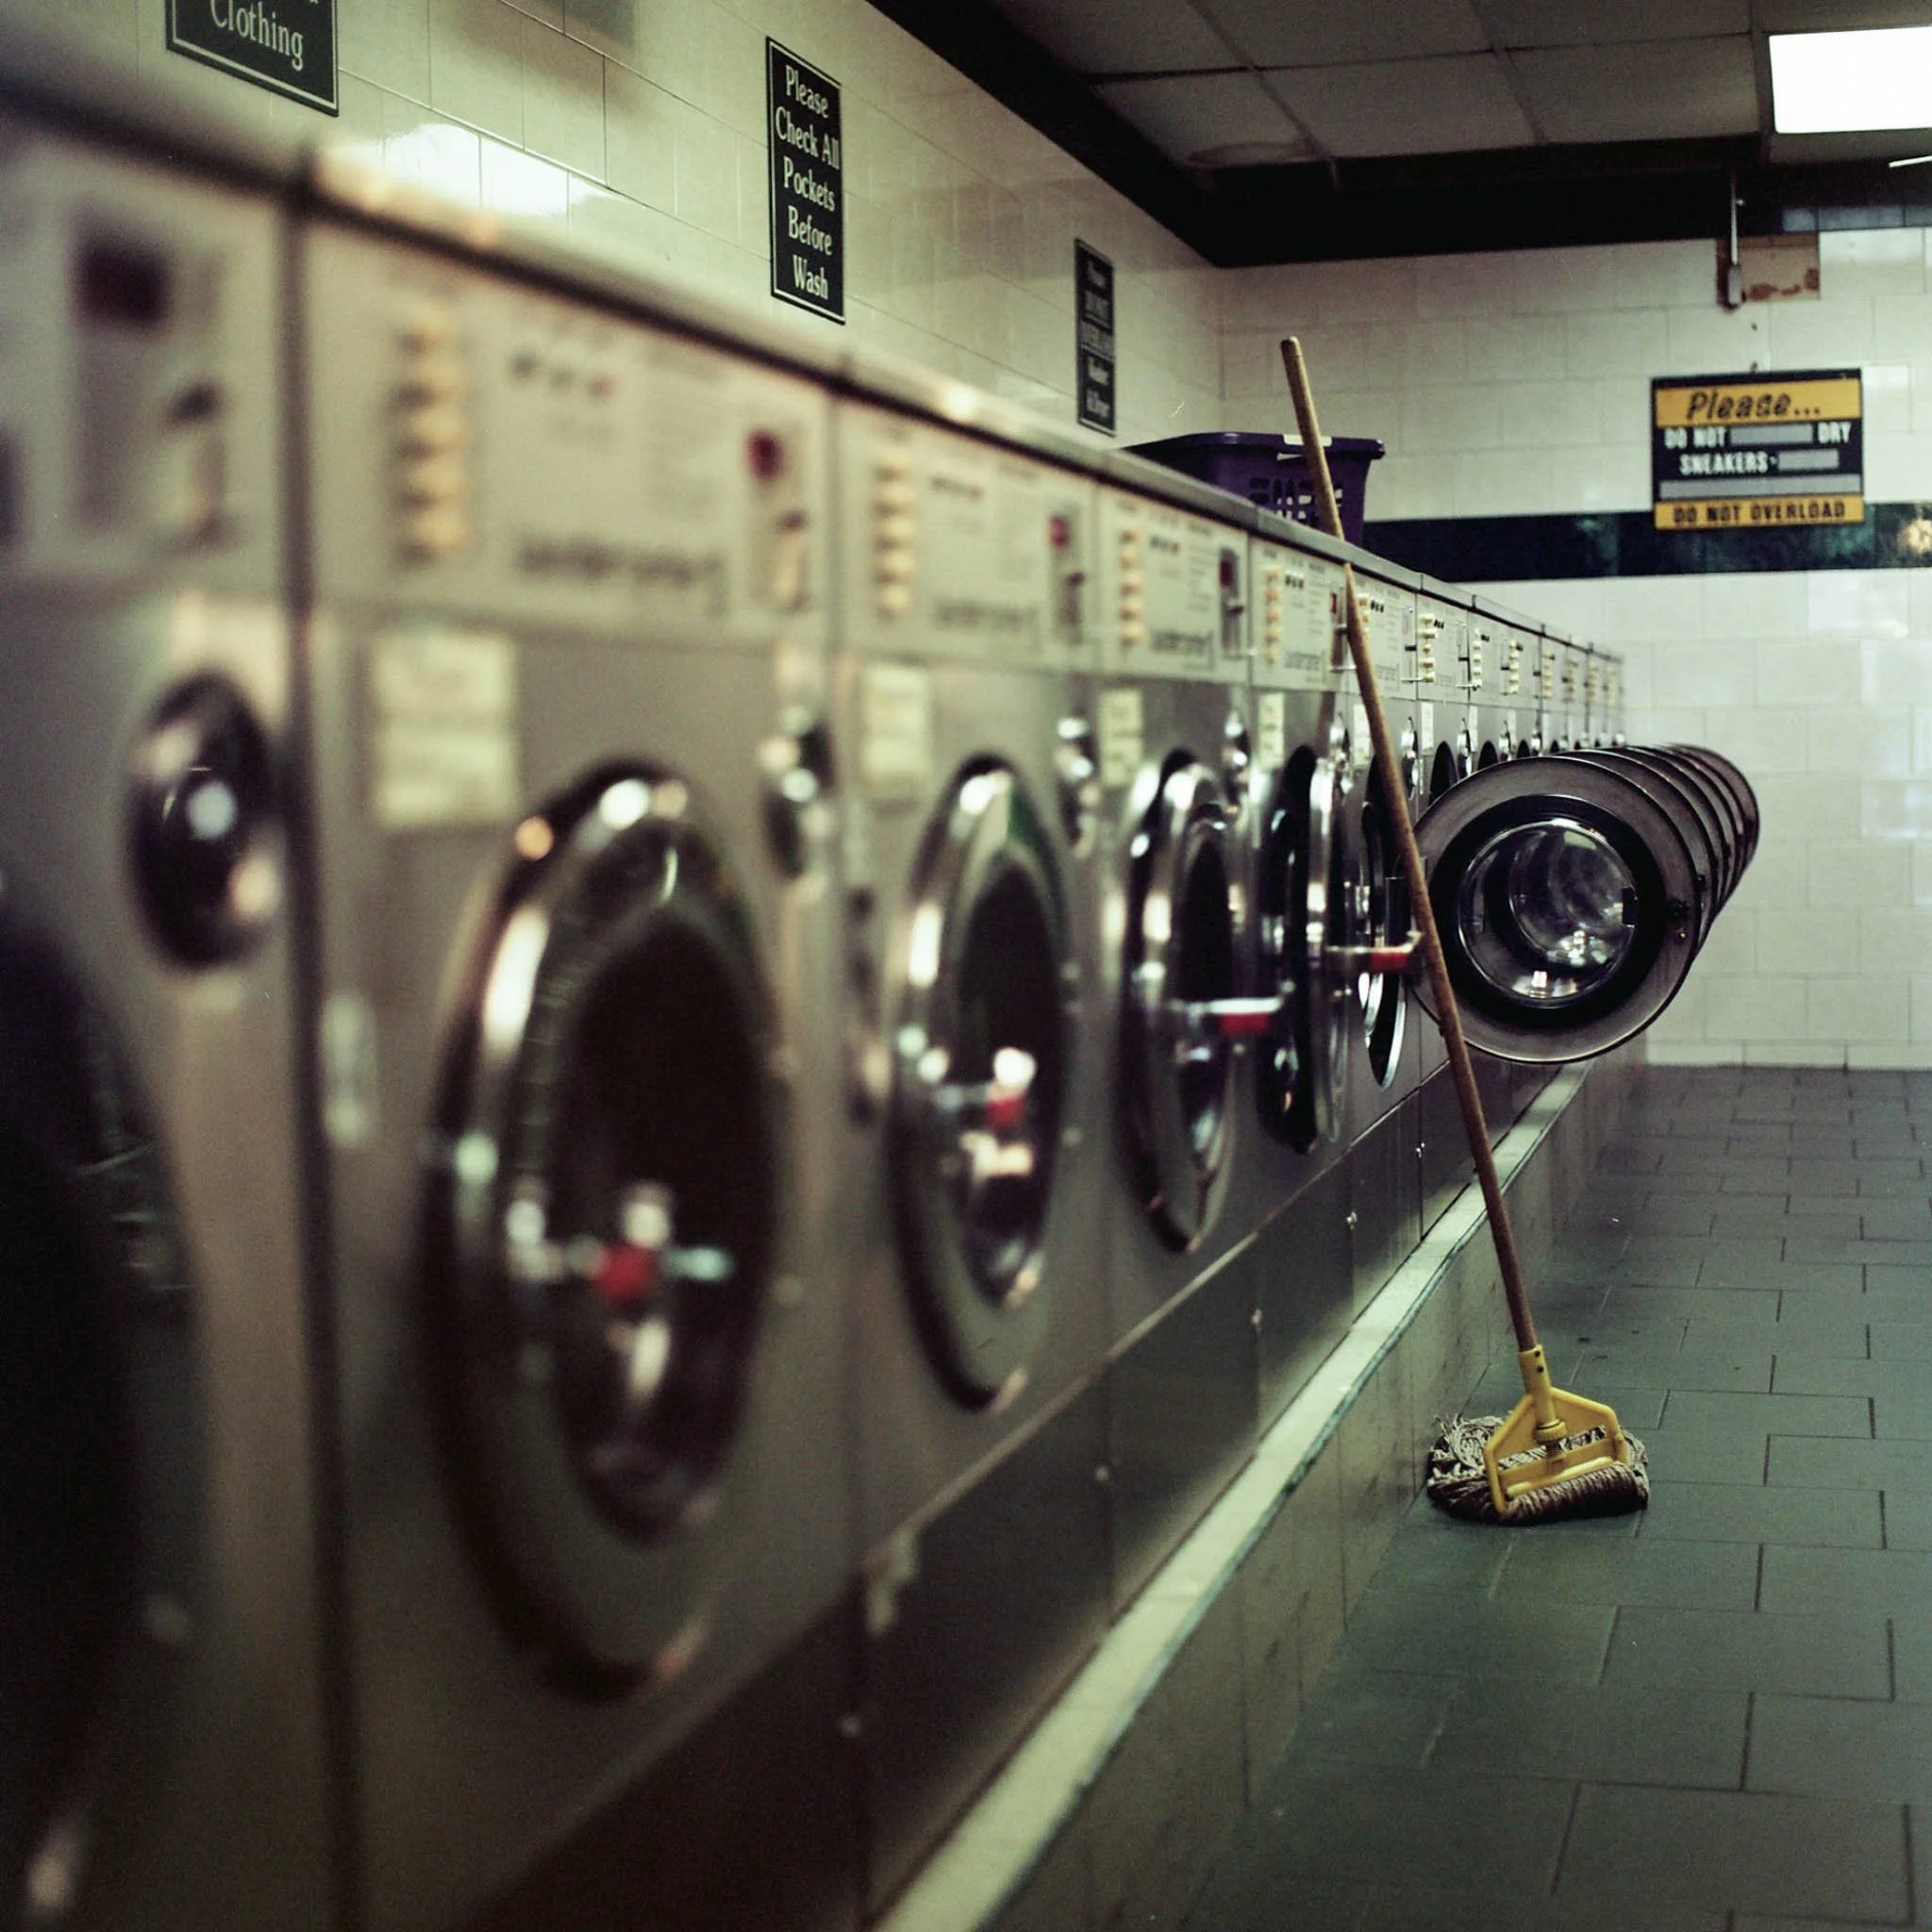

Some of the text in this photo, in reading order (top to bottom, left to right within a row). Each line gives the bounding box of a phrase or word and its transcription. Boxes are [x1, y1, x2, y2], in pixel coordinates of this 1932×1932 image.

[209, 0, 304, 72] Clothing
[785, 64, 829, 119] Please
[775, 106, 840, 170] Check All
[782, 156, 835, 212] Pockets
[788, 205, 833, 257] Before
[792, 254, 829, 300] Wash
[1686, 390, 1821, 421] Please...
[1663, 422, 1852, 449] DO NOT DRY
[1674, 501, 1845, 523] DO NOT OVERLOAD
